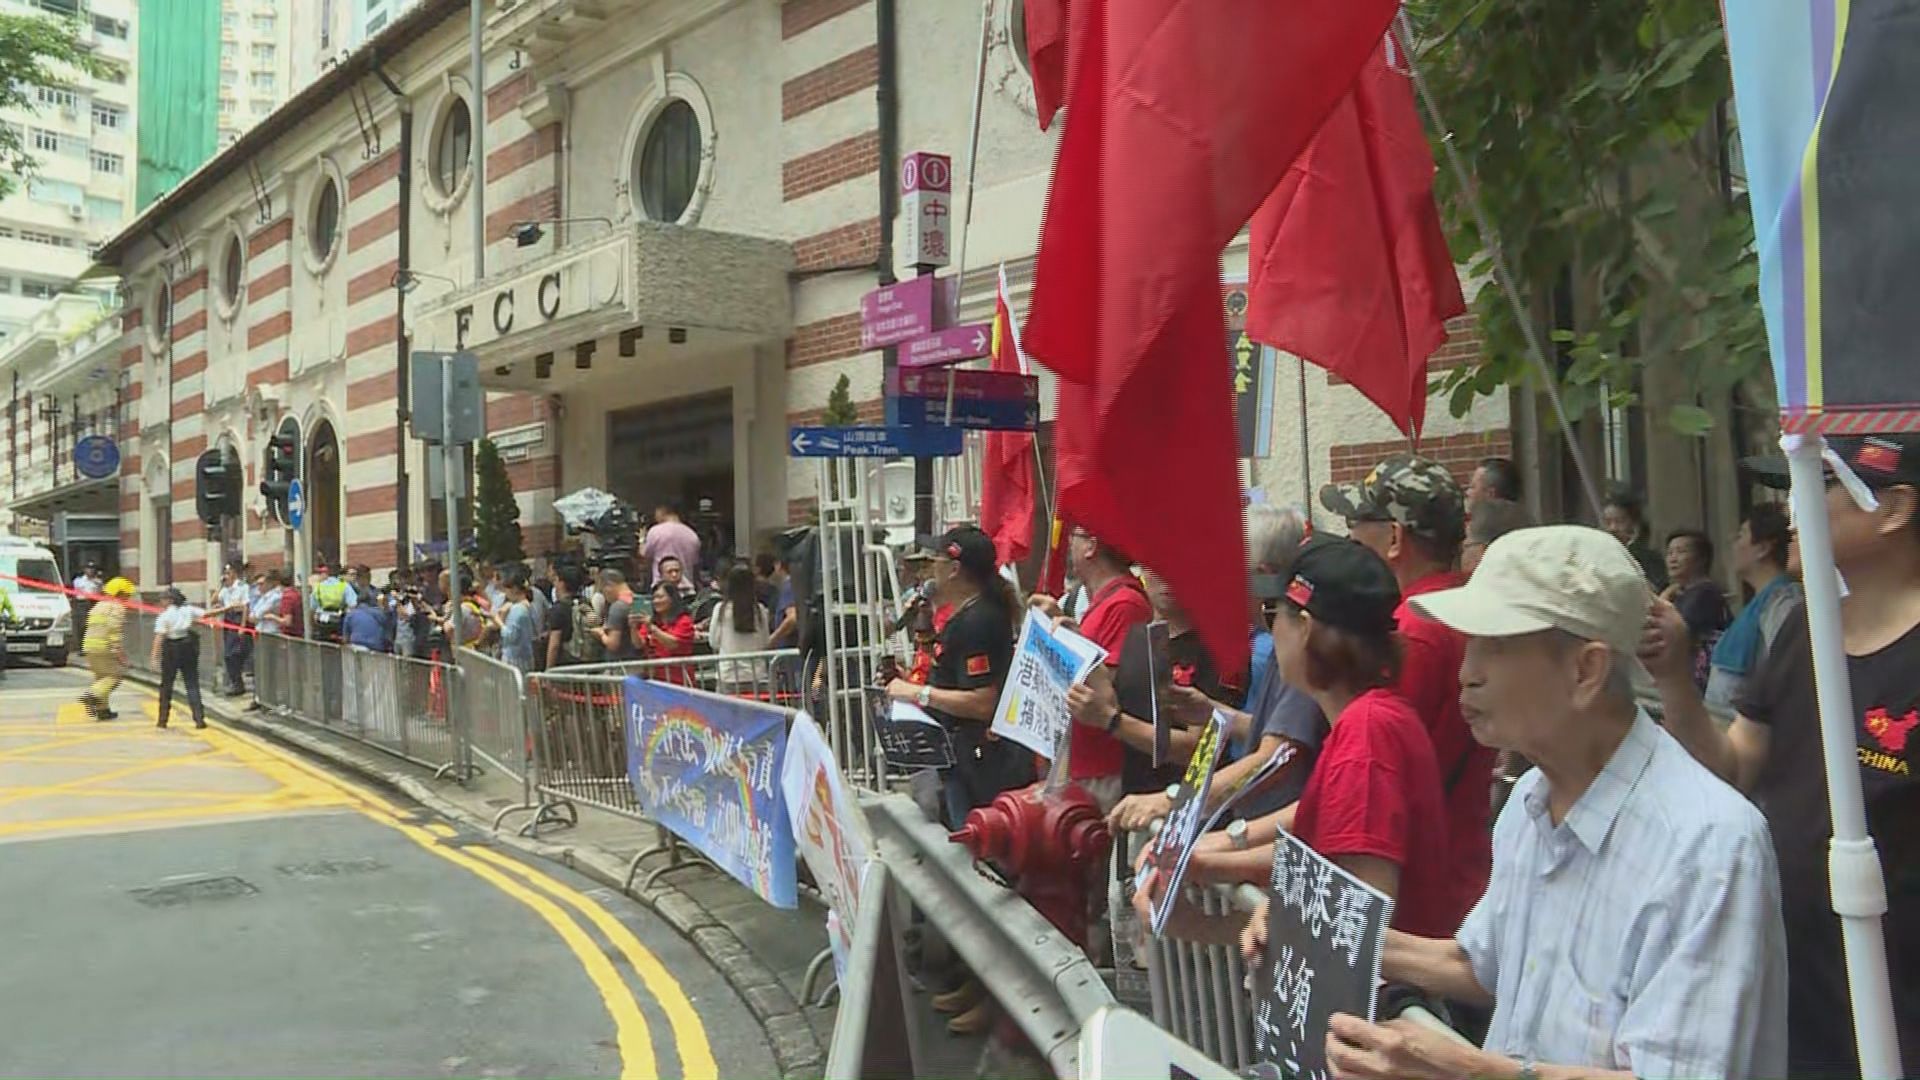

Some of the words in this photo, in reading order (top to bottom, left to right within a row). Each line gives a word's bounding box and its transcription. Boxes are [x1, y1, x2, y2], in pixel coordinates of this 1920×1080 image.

[922, 198, 948, 258] 中環
[843, 444, 869, 455] Peak
[872, 444, 899, 456] Tram
